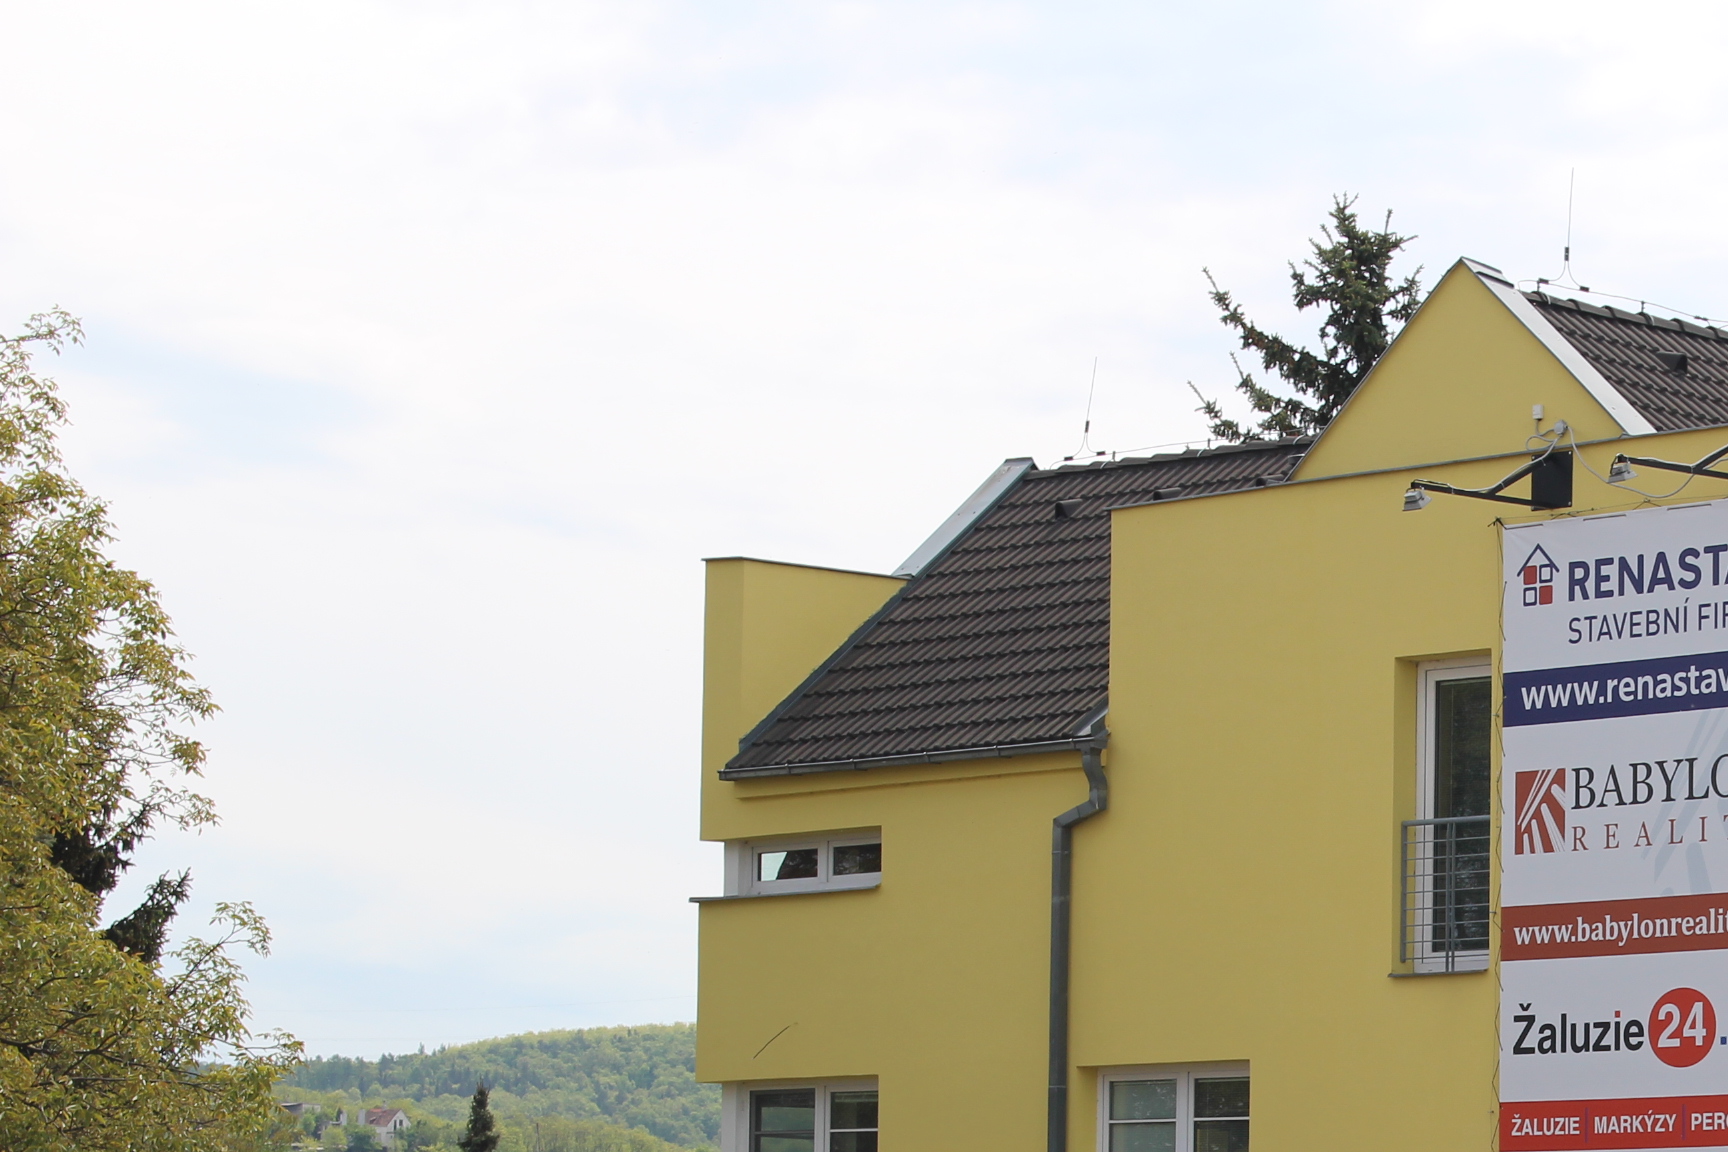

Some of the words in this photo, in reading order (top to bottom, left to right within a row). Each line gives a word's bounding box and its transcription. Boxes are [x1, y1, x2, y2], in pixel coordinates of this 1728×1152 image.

[1567, 597, 1690, 644] STAVEBNÍ
[1511, 1113, 1580, 1137] ŽALUZIE
[1593, 1109, 1677, 1135] MARKÝZY
